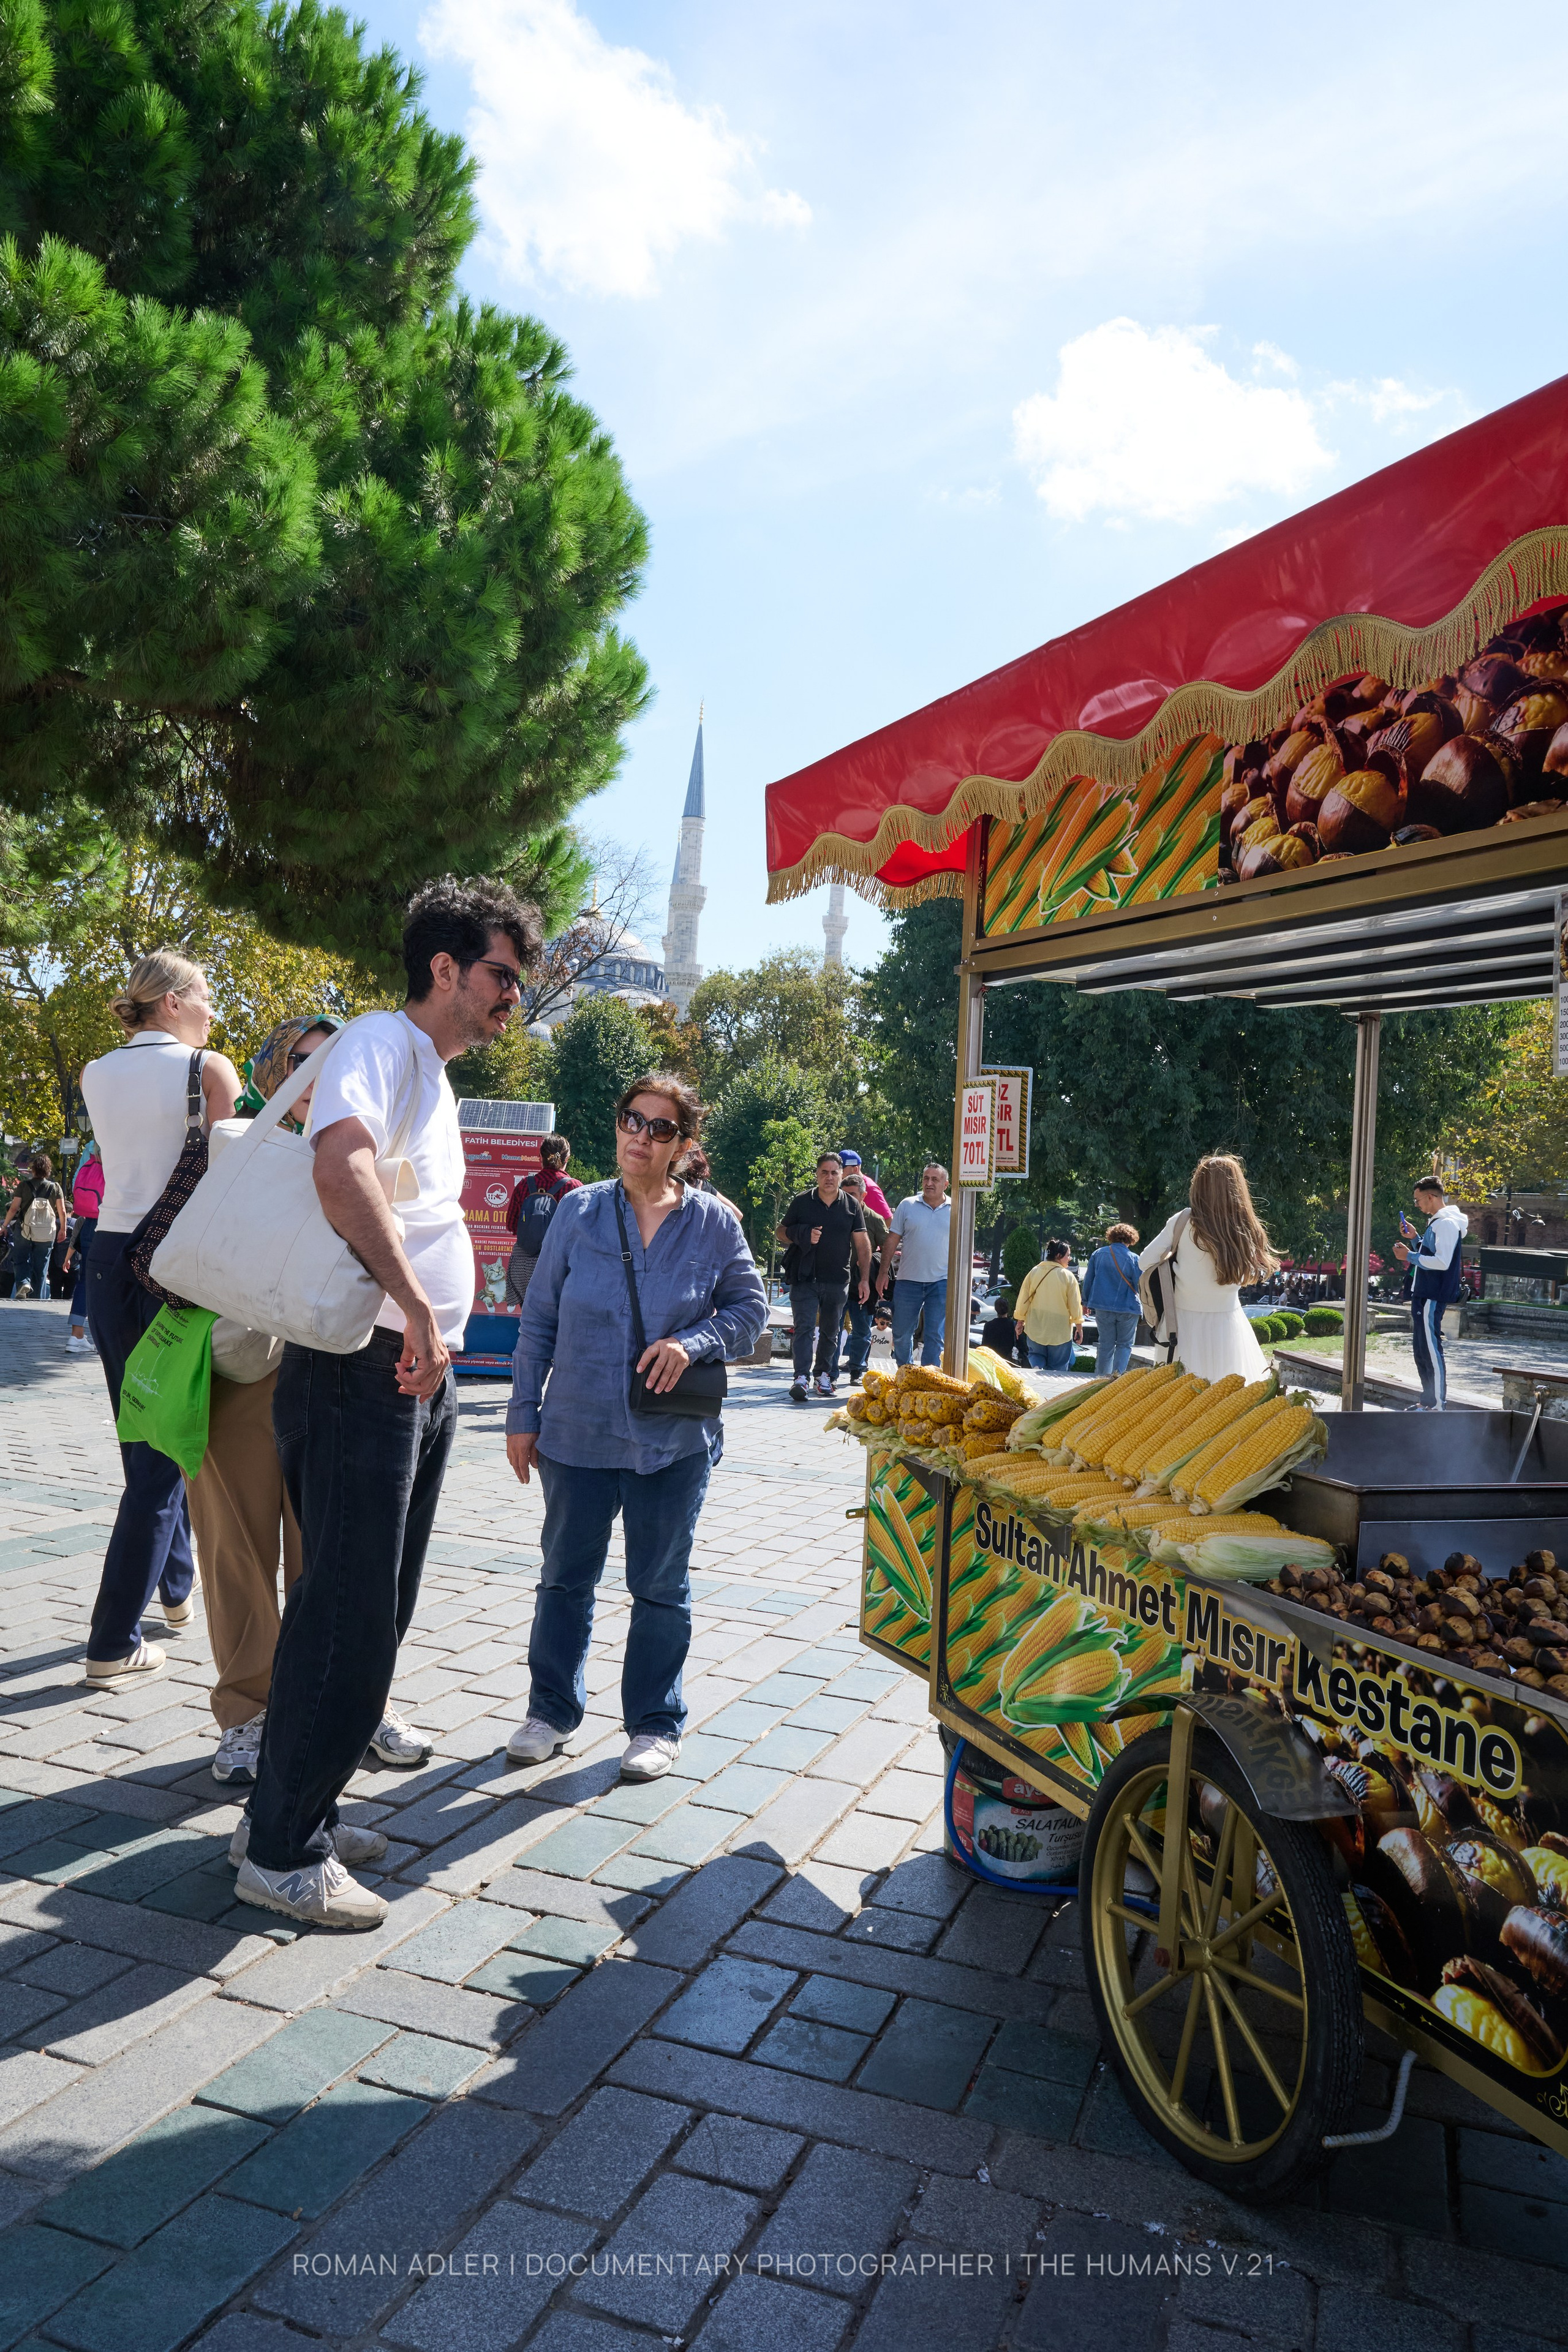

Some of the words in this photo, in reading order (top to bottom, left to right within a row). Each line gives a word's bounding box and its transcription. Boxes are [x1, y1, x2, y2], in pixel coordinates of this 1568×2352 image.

[968, 1091, 984, 1114] SÜT
[964, 1116, 986, 1134] MISIR
[491, 1139, 538, 1147] BELEDİYESİ
[501, 1153, 540, 1162] MamaMatik
[963, 1141, 986, 1164] 70TL
[871, 1334, 890, 1344] Boston
[974, 1501, 1063, 1586] Sultan
[1066, 1540, 1177, 1637] Ahmet
[1297, 1637, 1517, 1792] Kestane
